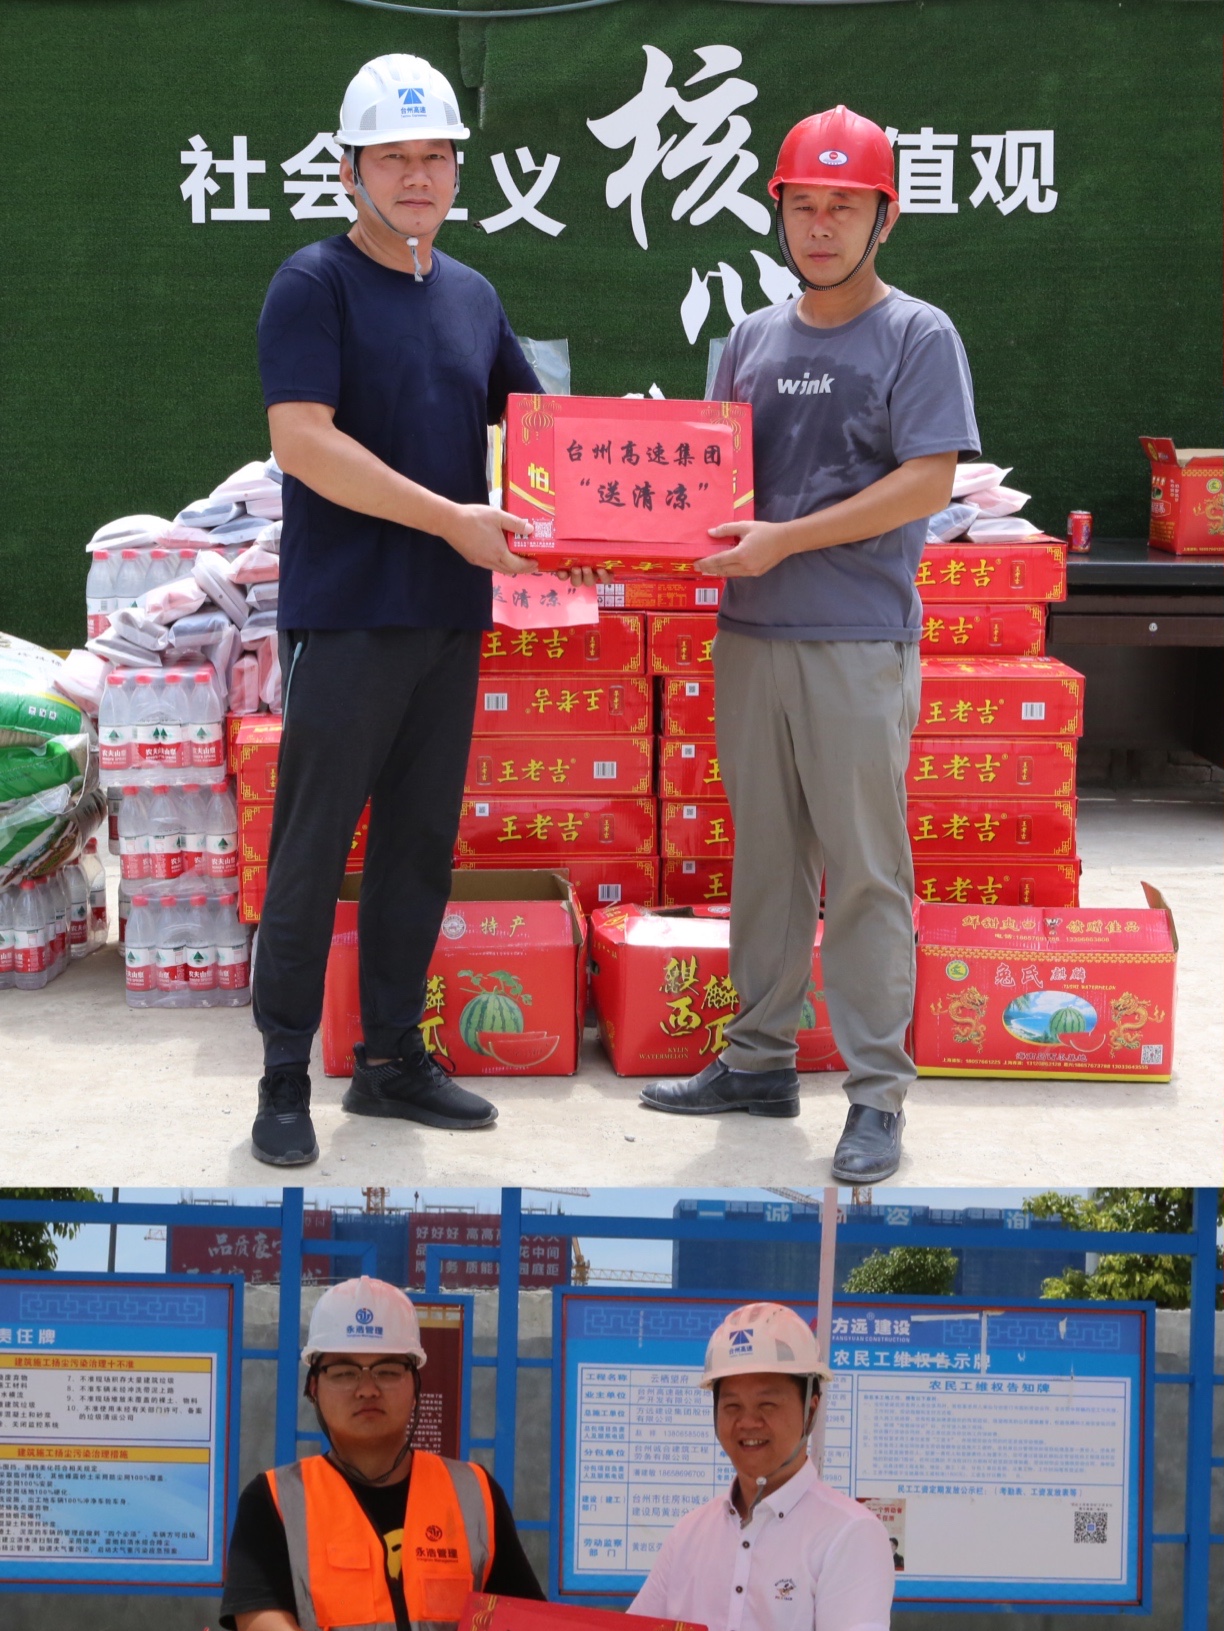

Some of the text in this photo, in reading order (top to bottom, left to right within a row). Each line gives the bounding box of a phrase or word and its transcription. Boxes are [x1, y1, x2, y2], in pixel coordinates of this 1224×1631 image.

[776, 372, 835, 396] wink
[566, 439, 722, 467] 台州高速集团
[914, 559, 995, 587] 王老吉
[482, 629, 568, 659] 王老吉
[531, 687, 604, 713] 王老吉
[925, 699, 999, 725] 王老吉
[497, 758, 570, 783] 王老吉
[913, 754, 1000, 783] 王老吉
[497, 812, 583, 842] 王老吉
[913, 813, 1000, 842] 王老吉
[921, 876, 1002, 905] 王老吉
[346, 1325, 384, 1335] 永浩管理
[832, 1317, 911, 1336] 方远建设
[928, 1380, 1051, 1394] 农民工维权告知牌
[416, 1547, 458, 1558] 永浩管理
